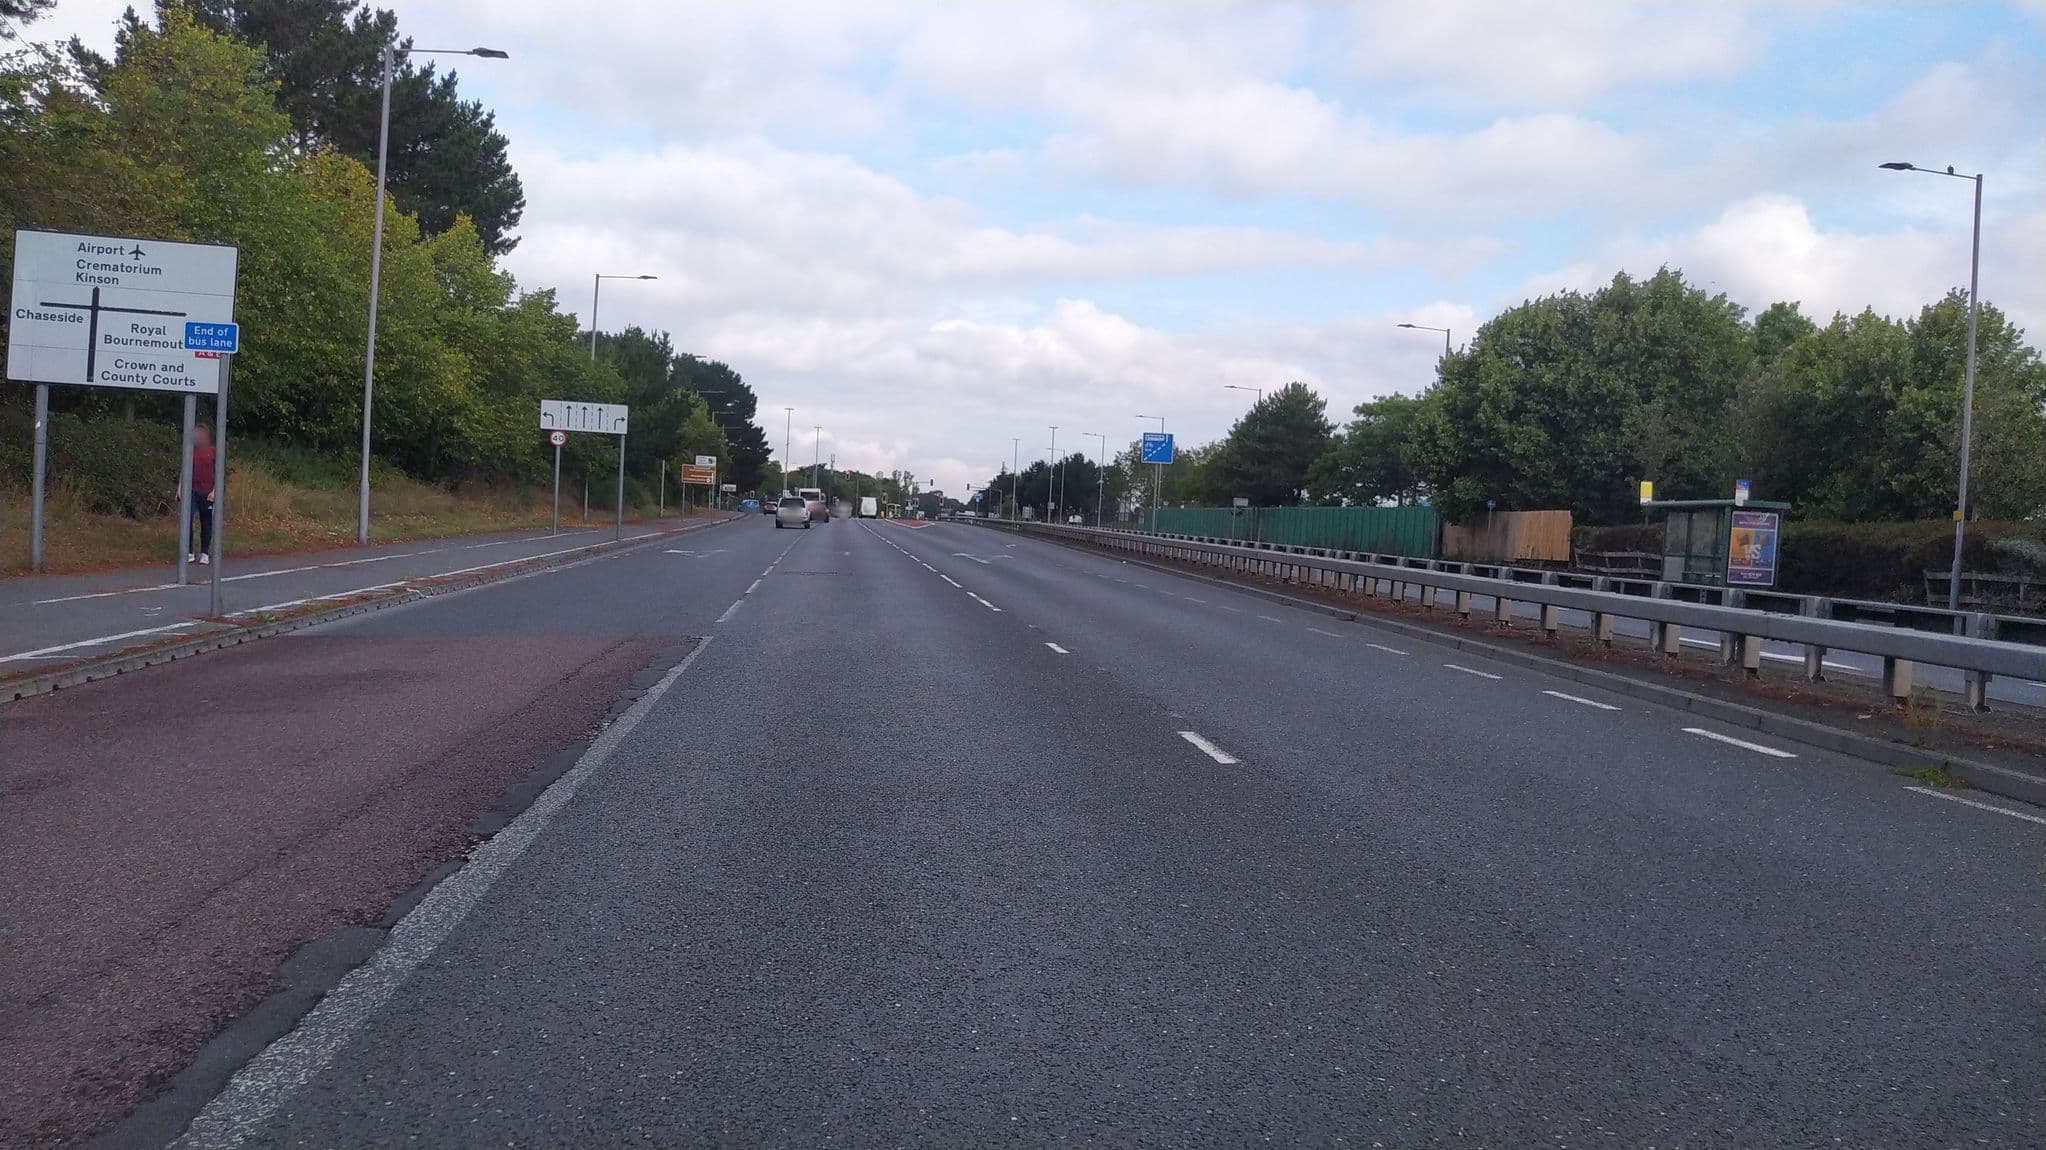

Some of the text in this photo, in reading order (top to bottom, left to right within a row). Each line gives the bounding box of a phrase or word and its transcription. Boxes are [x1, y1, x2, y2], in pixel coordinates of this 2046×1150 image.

[77, 242, 125, 256] Airport
[76, 259, 162, 275] Crematorium
[76, 272, 119, 285] Kinson
[16, 309, 84, 324] Chaseside
[131, 323, 167, 337] Royal
[194, 326, 229, 337] End of
[104, 334, 184, 350] Bournemout
[188, 336, 233, 348] bus lane
[114, 358, 185, 373] Crown and
[101, 370, 197, 387] County Courts
